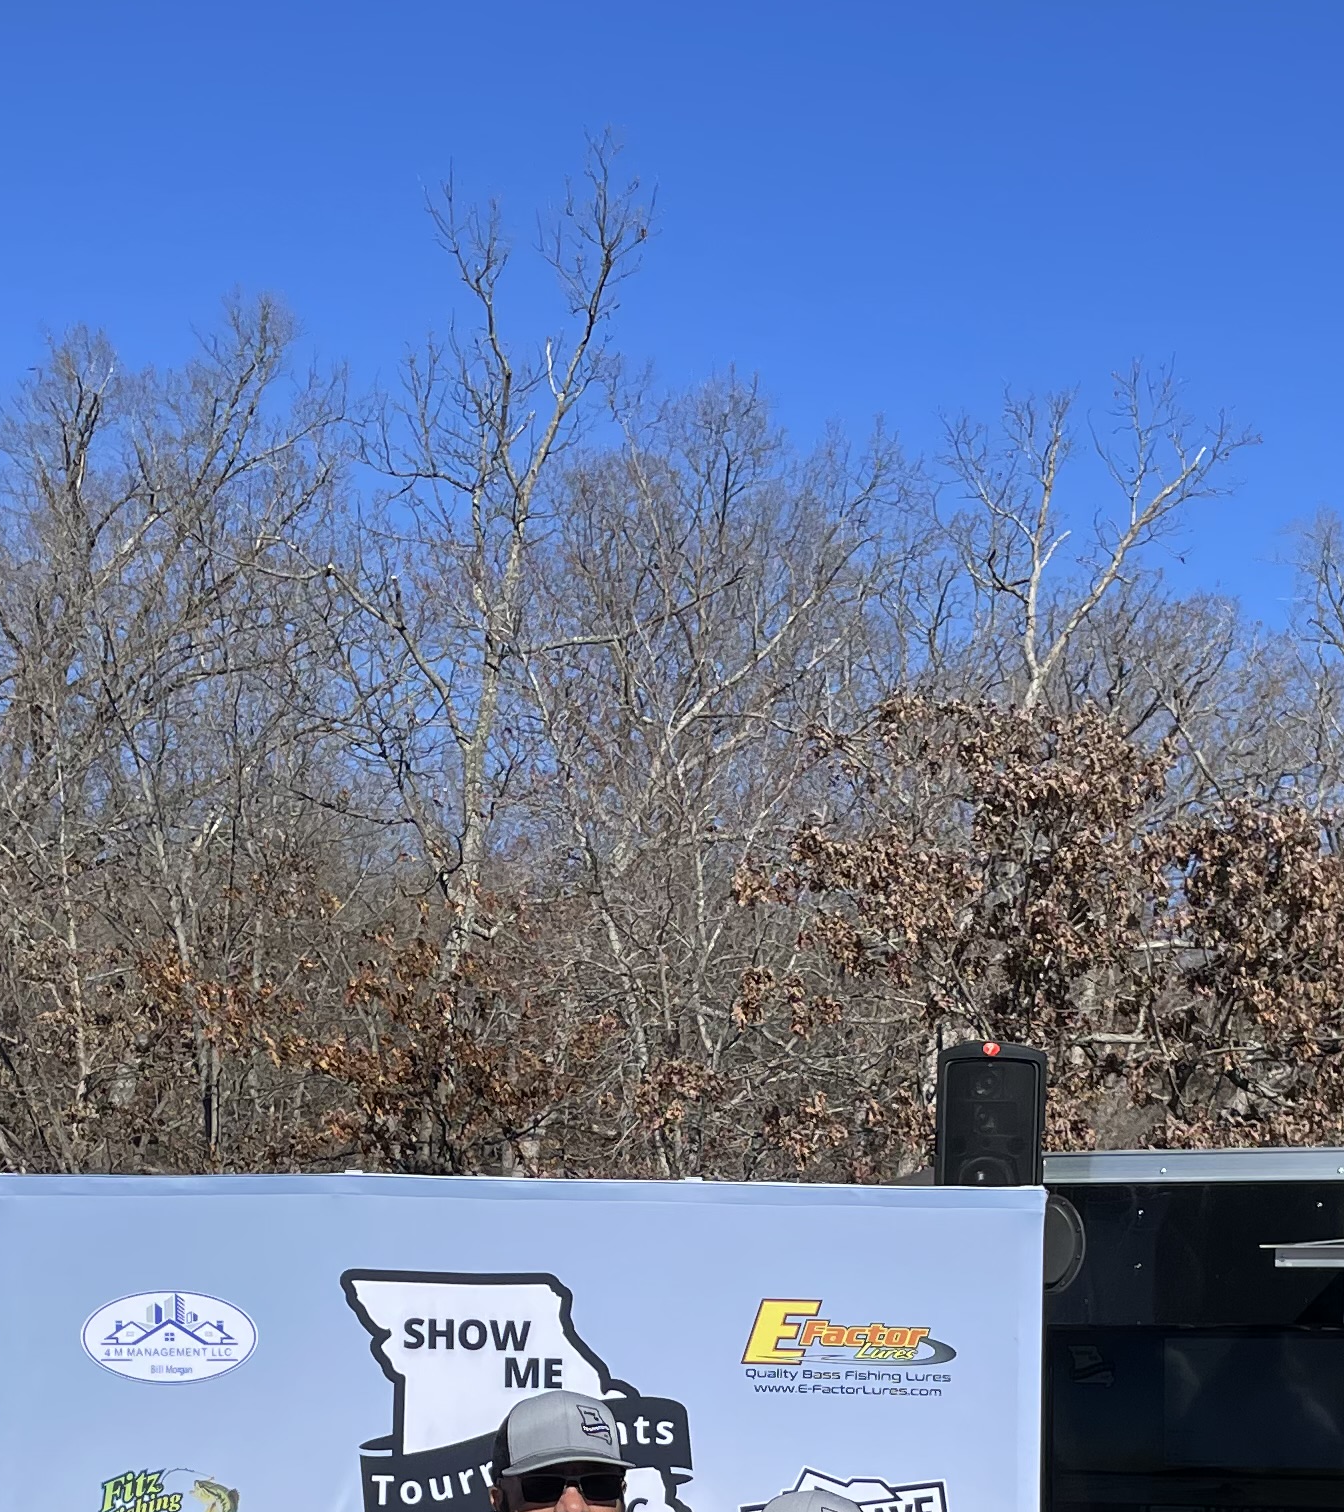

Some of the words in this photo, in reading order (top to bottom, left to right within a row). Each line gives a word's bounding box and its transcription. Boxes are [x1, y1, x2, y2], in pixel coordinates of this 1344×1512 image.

[403, 1319, 532, 1351] SHOW
[799, 1319, 931, 1348] Factor
[104, 1348, 111, 1357] 4
[114, 1348, 123, 1357] M
[127, 1348, 207, 1357] MANAGEMENT
[211, 1348, 232, 1357] LLC
[854, 1342, 919, 1360] Lures
[150, 1365, 164, 1374] Bill
[165, 1365, 193, 1376] Morgan
[505, 1357, 563, 1389] ME
[745, 1369, 798, 1380] Quality
[802, 1370, 840, 1380] Bass
[845, 1371, 901, 1383] Fishing
[906, 1372, 951, 1382] Lures
[754, 1384, 942, 1397] www.E-FactorLures.com
